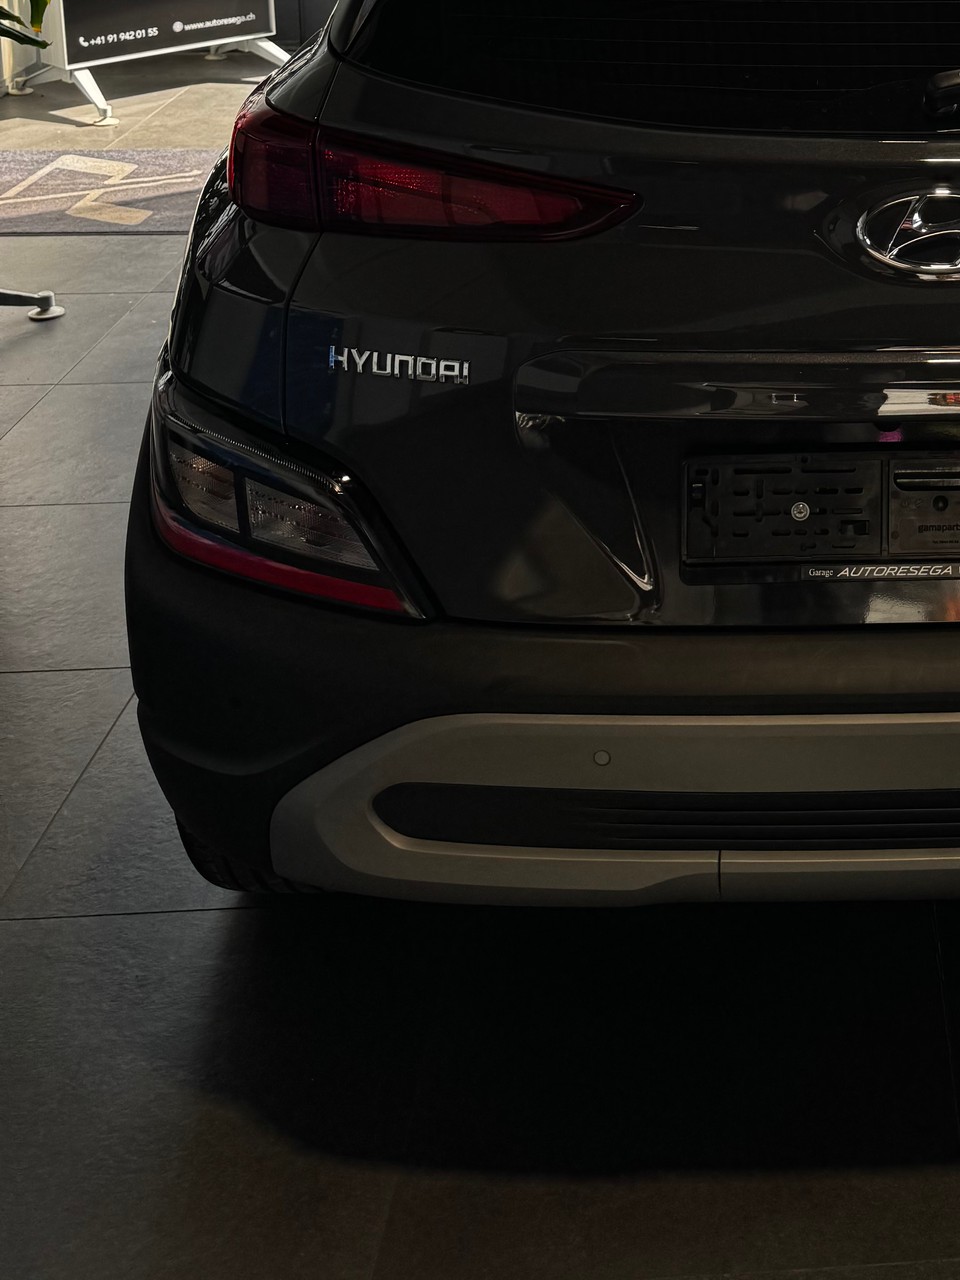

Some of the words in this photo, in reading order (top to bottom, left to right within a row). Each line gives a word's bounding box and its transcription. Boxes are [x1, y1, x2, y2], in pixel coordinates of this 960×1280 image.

[89, 35, 105, 46] +41
[107, 34, 118, 44] 91
[119, 31, 135, 41] 942
[135, 29, 146, 39] 01
[147, 27, 159, 37] 55
[184, 12, 256, 31] www.autoresega.ch
[328, 344, 471, 385] HYUNDAI
[808, 567, 834, 578] Garage
[837, 565, 953, 578] AUTORESEGA
